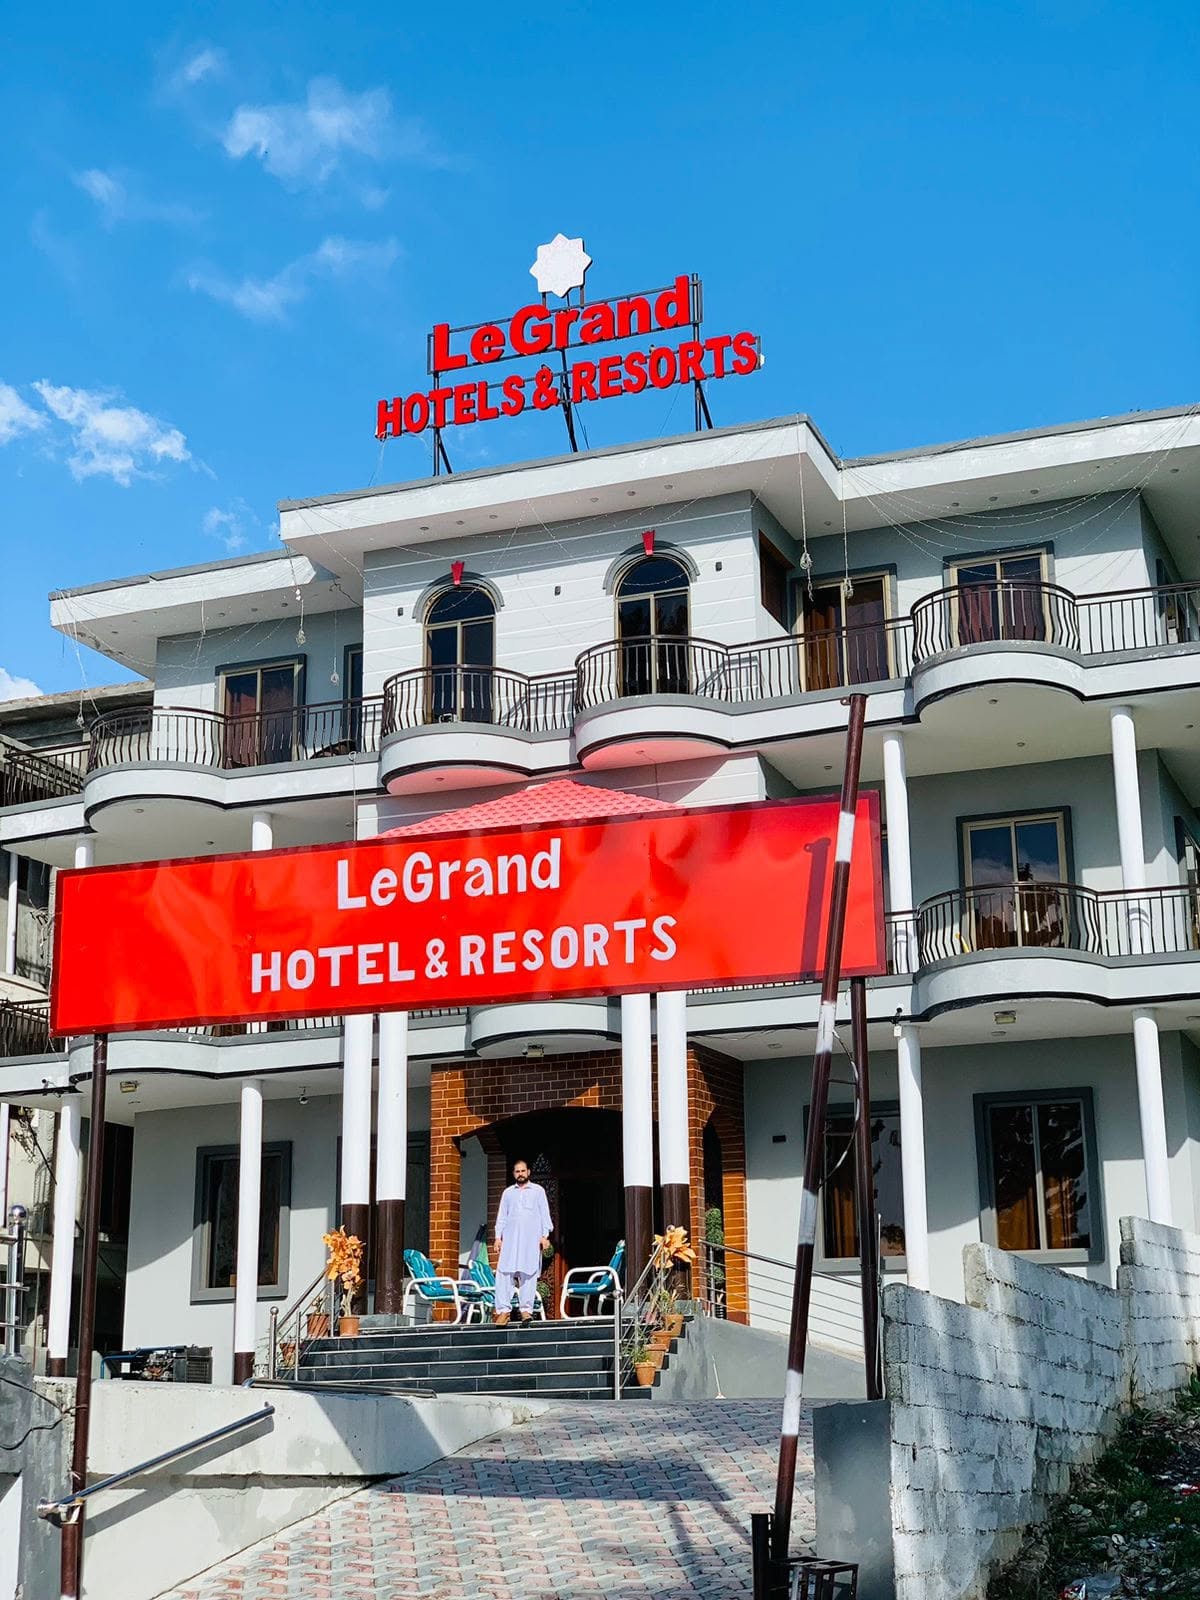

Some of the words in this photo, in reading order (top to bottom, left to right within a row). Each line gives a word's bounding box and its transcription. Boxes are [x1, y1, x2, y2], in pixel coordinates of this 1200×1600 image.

[432, 274, 691, 372] LeGrand
[377, 374, 525, 437] HOTELS
[533, 365, 559, 410] &
[571, 332, 758, 403] RESORTS
[337, 837, 562, 910] LeGrand
[251, 942, 415, 993] HOTEL
[424, 938, 448, 979] &
[459, 915, 678, 976] RESORTS
